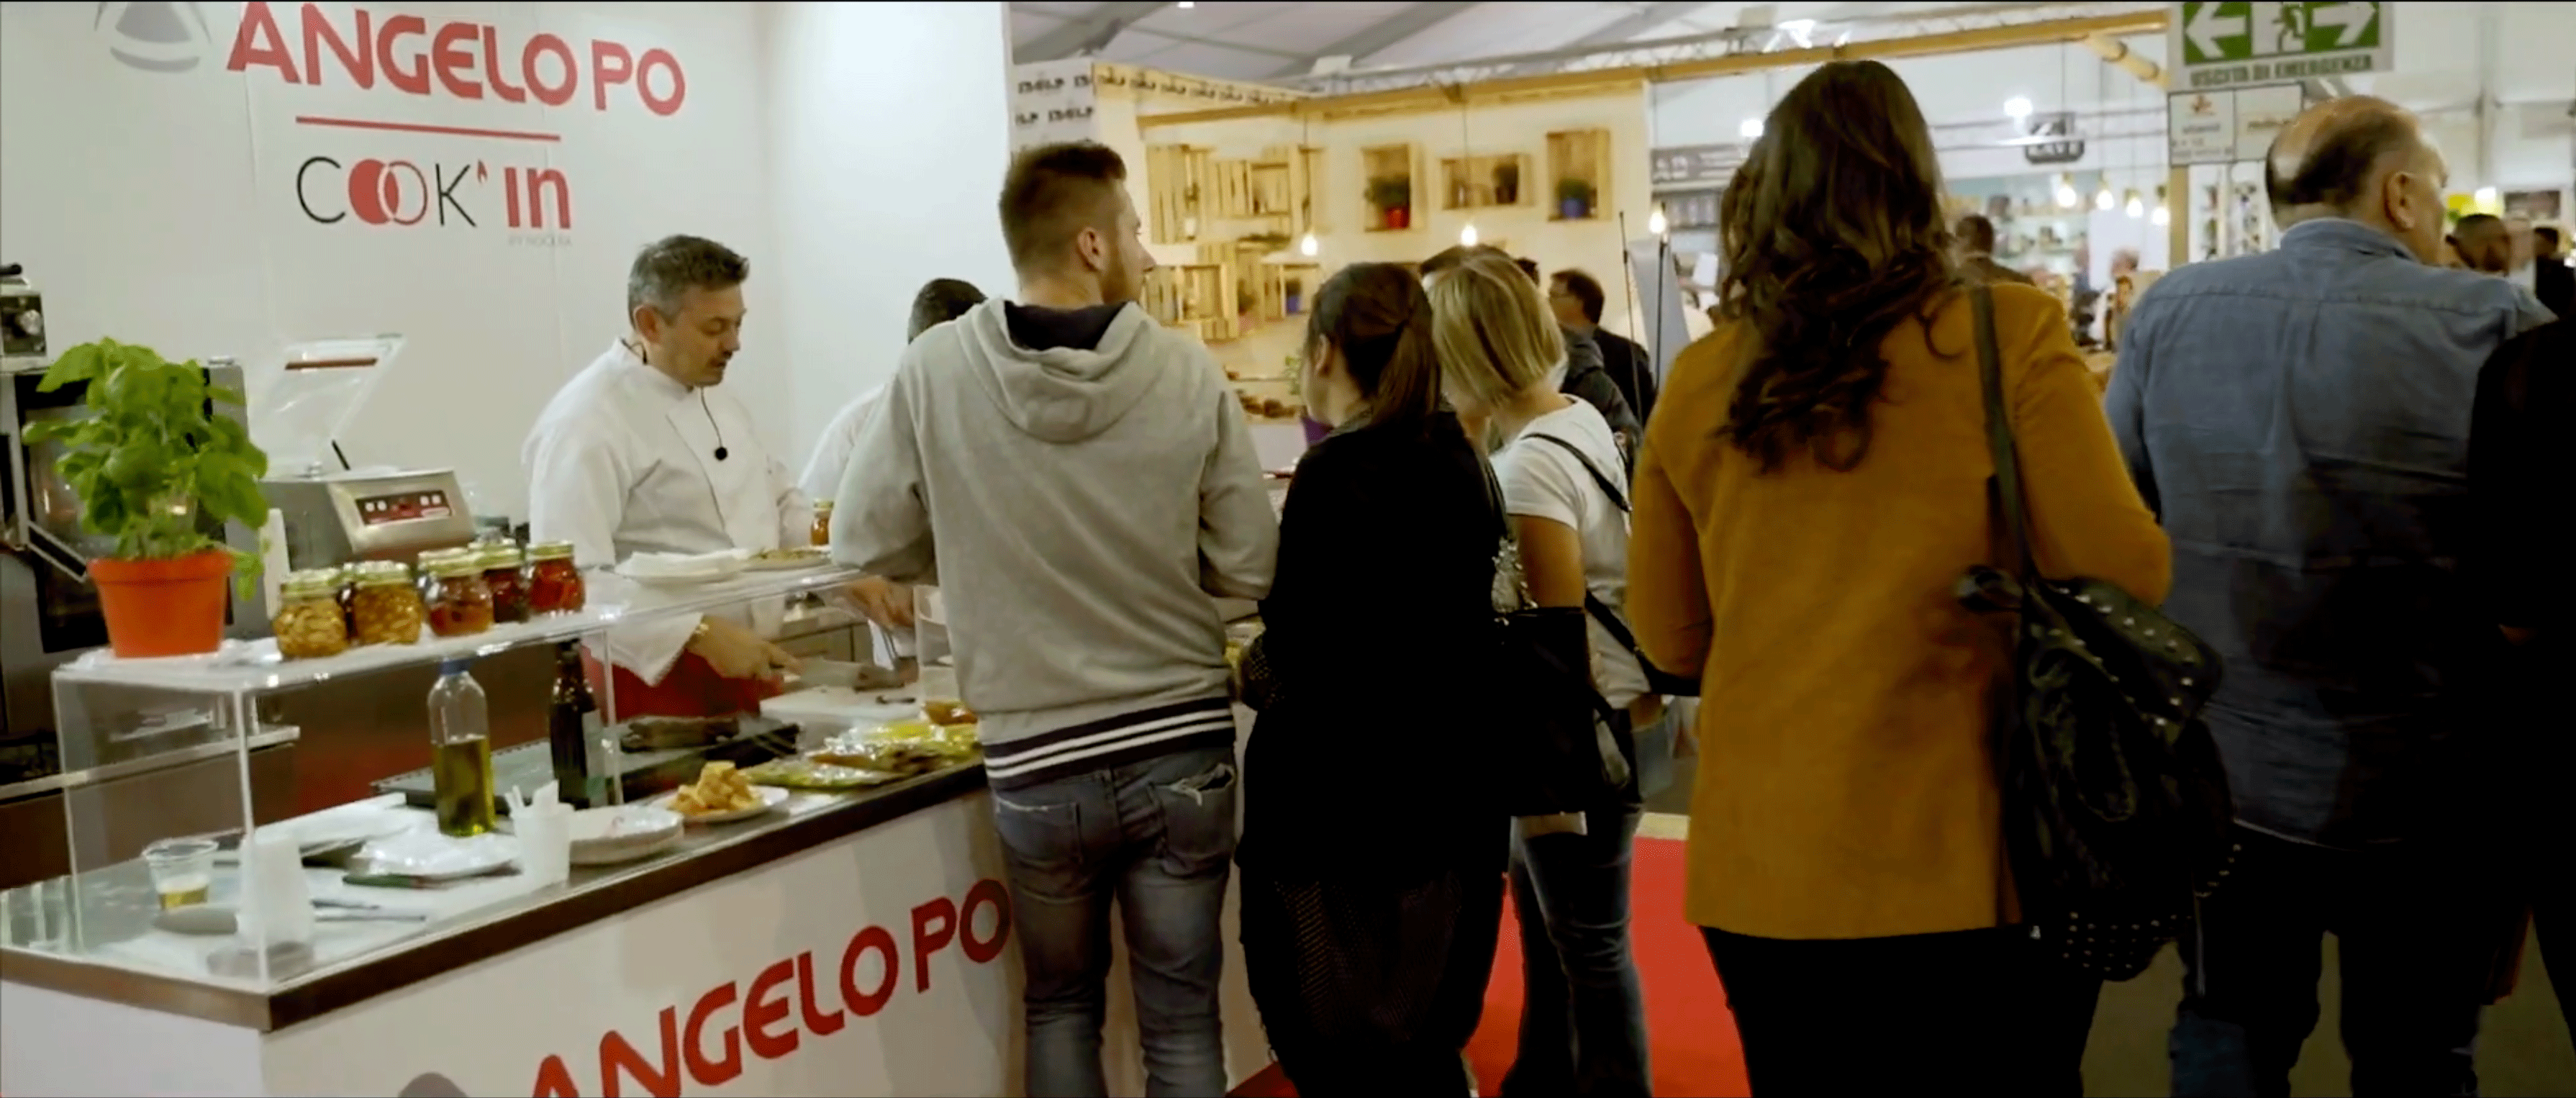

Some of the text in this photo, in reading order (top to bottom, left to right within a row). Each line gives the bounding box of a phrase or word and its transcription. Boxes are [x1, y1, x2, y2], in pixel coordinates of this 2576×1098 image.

[227, 1, 686, 116] ANGELO PO
[2253, 63, 2271, 81] DI
[910, 879, 1012, 994] PO
